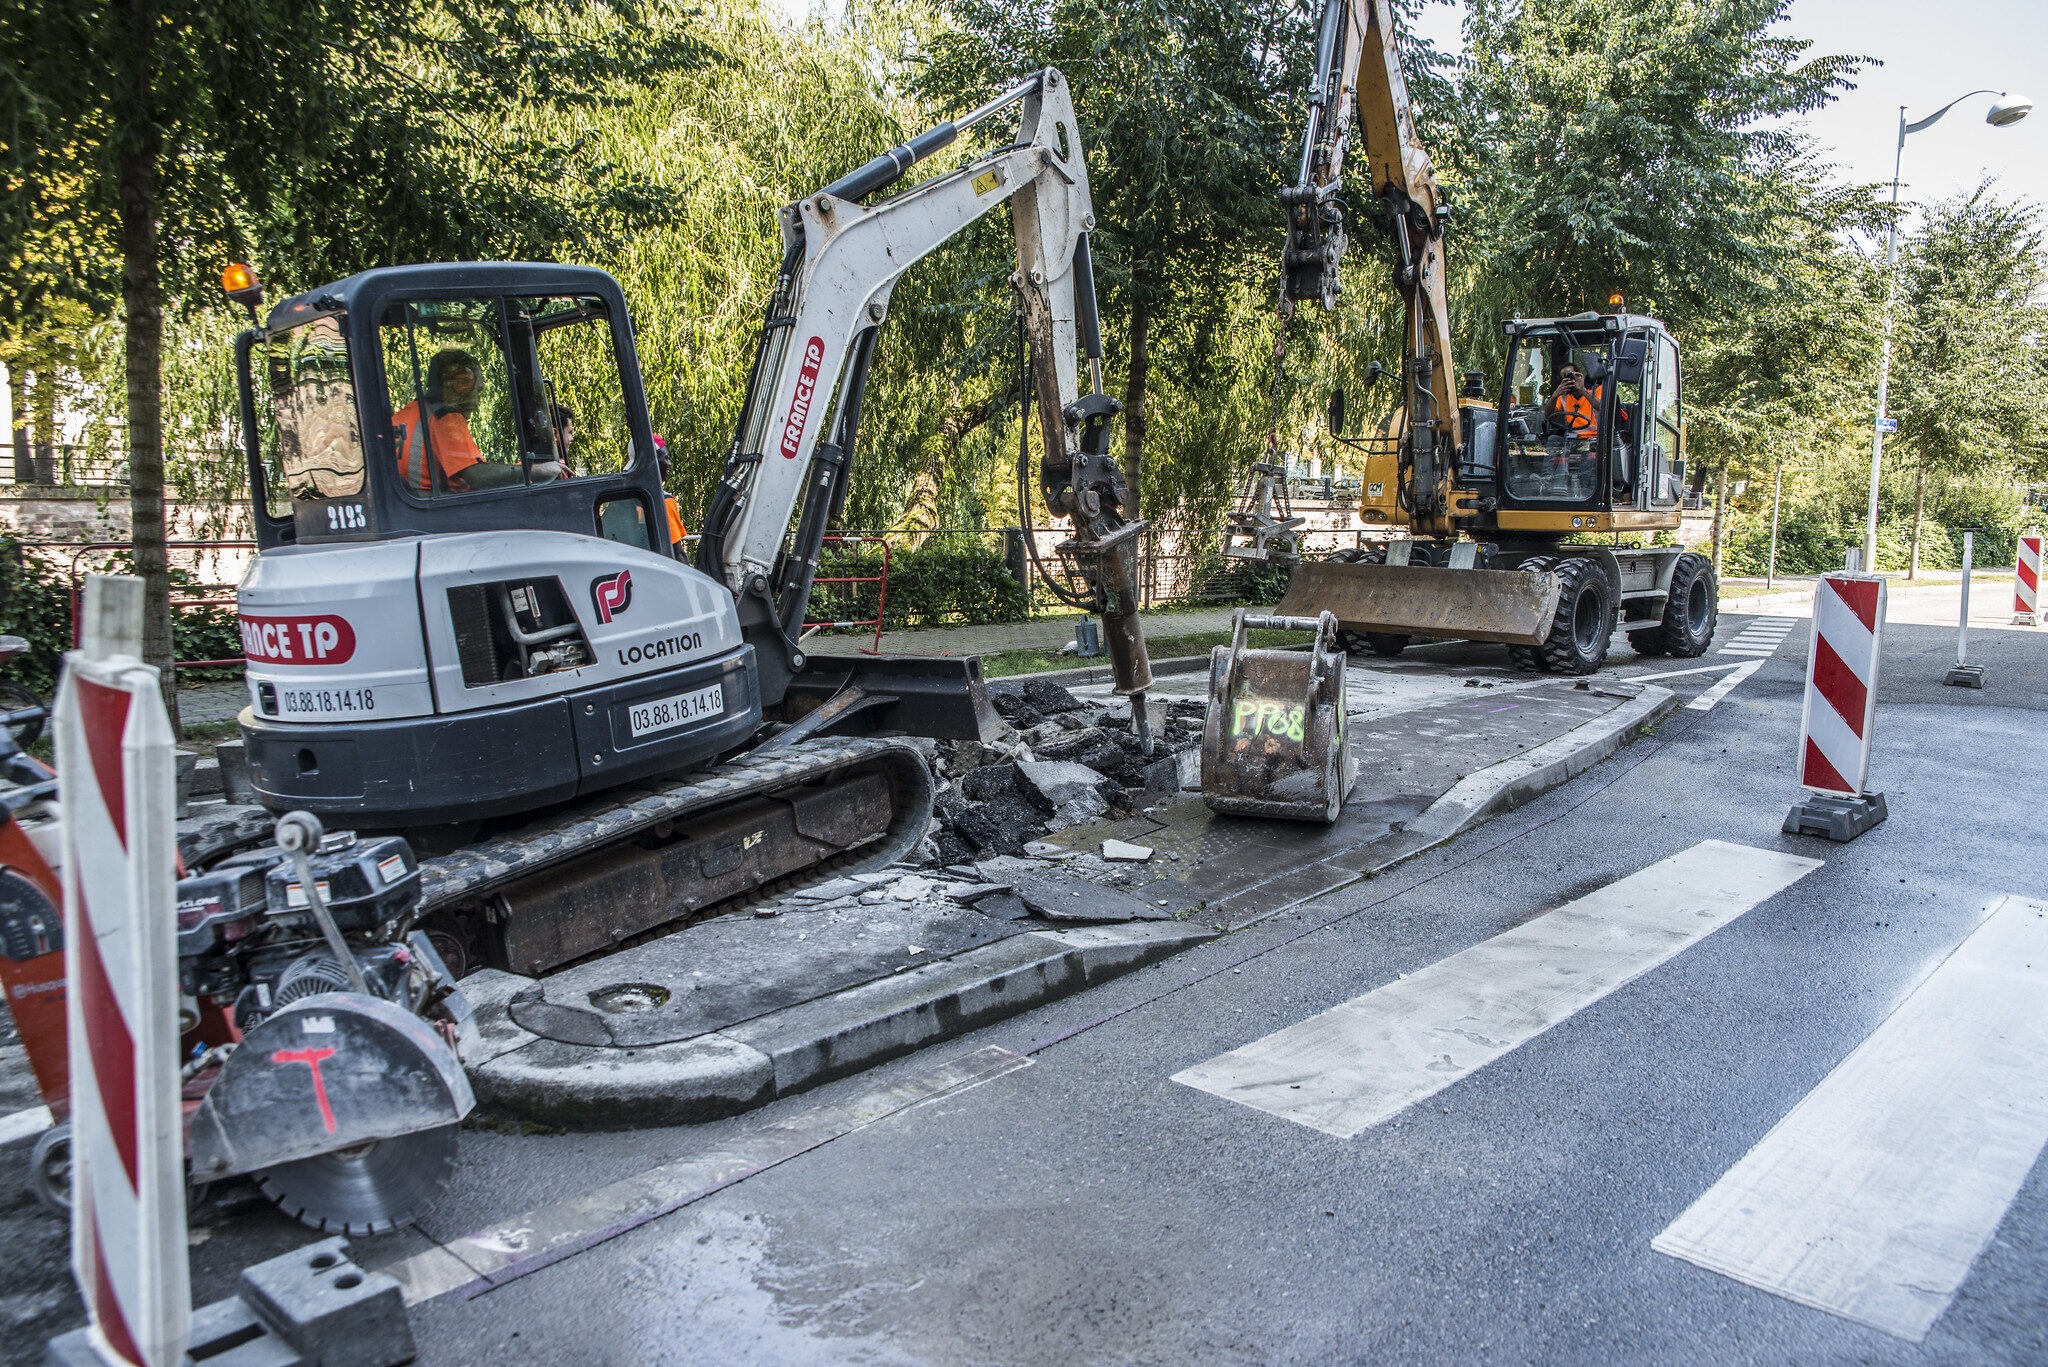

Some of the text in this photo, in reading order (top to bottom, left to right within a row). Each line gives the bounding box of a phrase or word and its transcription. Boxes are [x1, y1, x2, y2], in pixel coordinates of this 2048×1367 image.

[783, 344, 820, 452] FRANCE TP
[327, 504, 366, 529] 2123
[238, 619, 339, 658] ANCE TP
[618, 632, 702, 666] LOCATION
[285, 689, 375, 712] 03.88.18.14.18
[633, 689, 722, 731] 03.88.18.14.18
